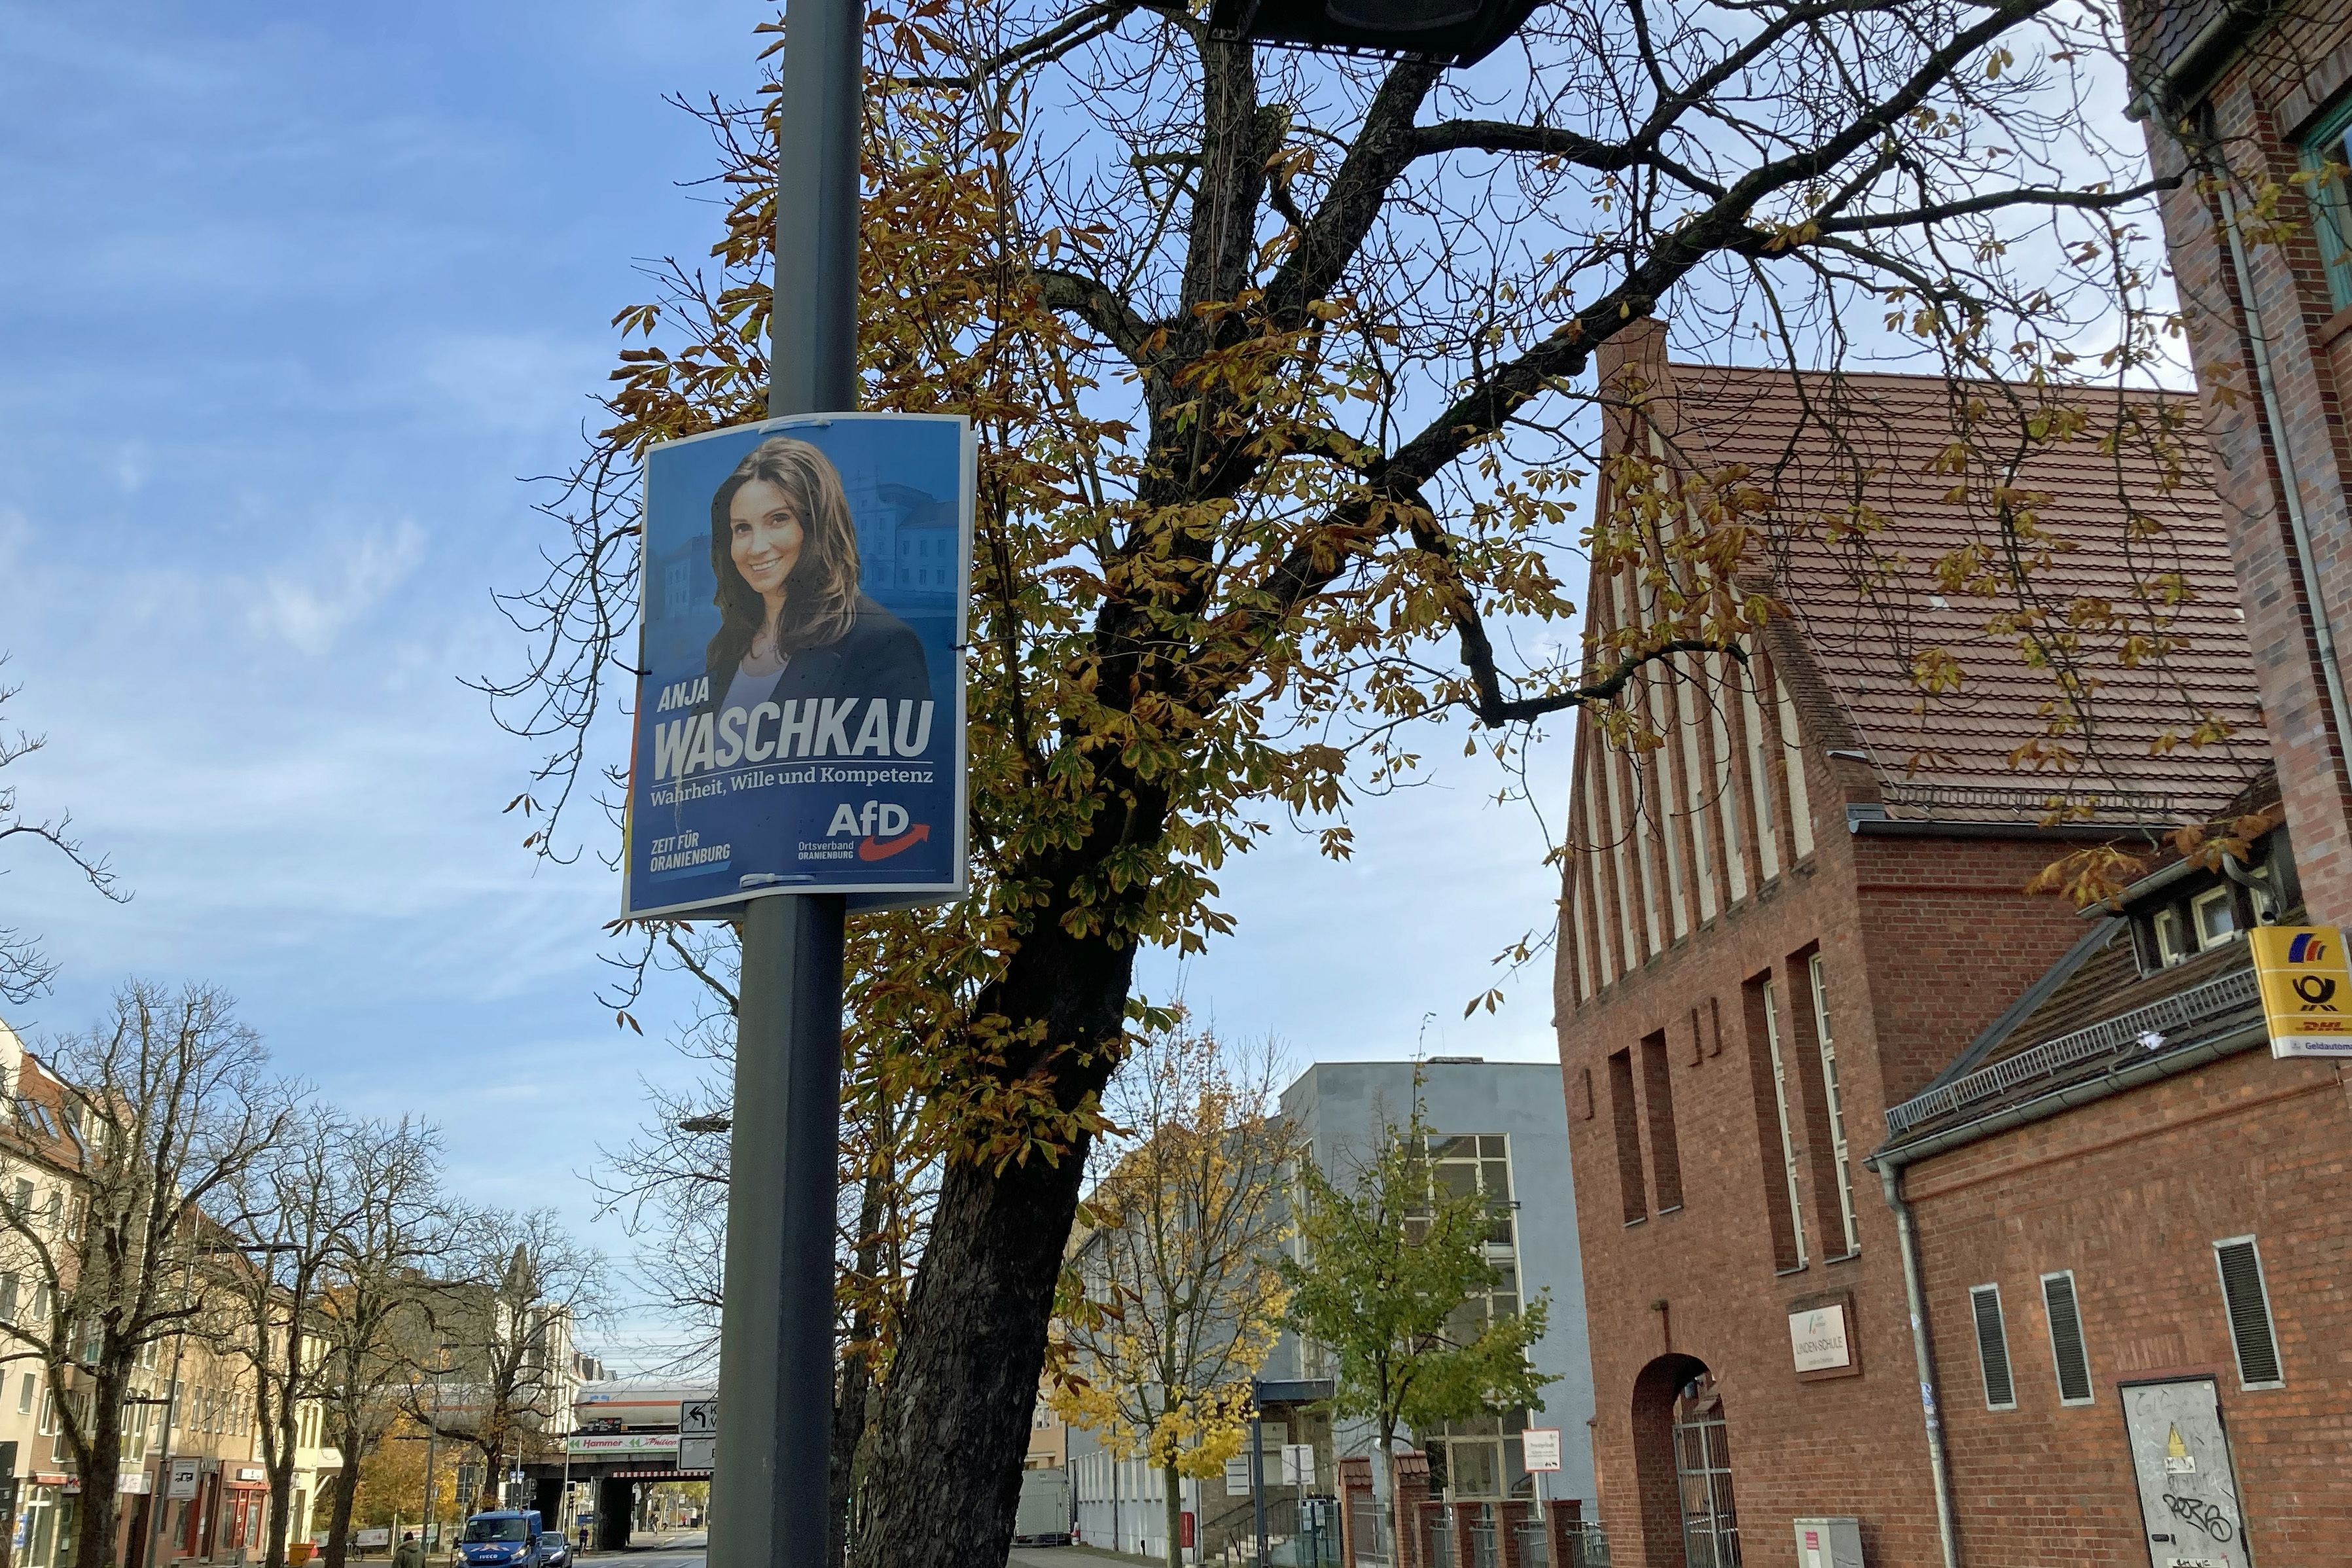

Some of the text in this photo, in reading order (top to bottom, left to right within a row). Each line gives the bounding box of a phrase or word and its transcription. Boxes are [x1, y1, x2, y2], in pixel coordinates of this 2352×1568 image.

[656, 676, 709, 713] ANJA
[655, 697, 935, 781] WASCHKAU
[650, 766, 933, 807] Wahrheit, Wille und Kompetenz
[826, 800, 910, 837] AfD
[650, 829, 700, 855] ZEIT FÜR
[798, 840, 854, 851] Ortsverband
[798, 851, 853, 861] ORANIENBURG
[650, 843, 731, 873] ORANIENBURG
[2304, 1022, 2343, 1031] DHL
[583, 1438, 622, 1448] Hammer
